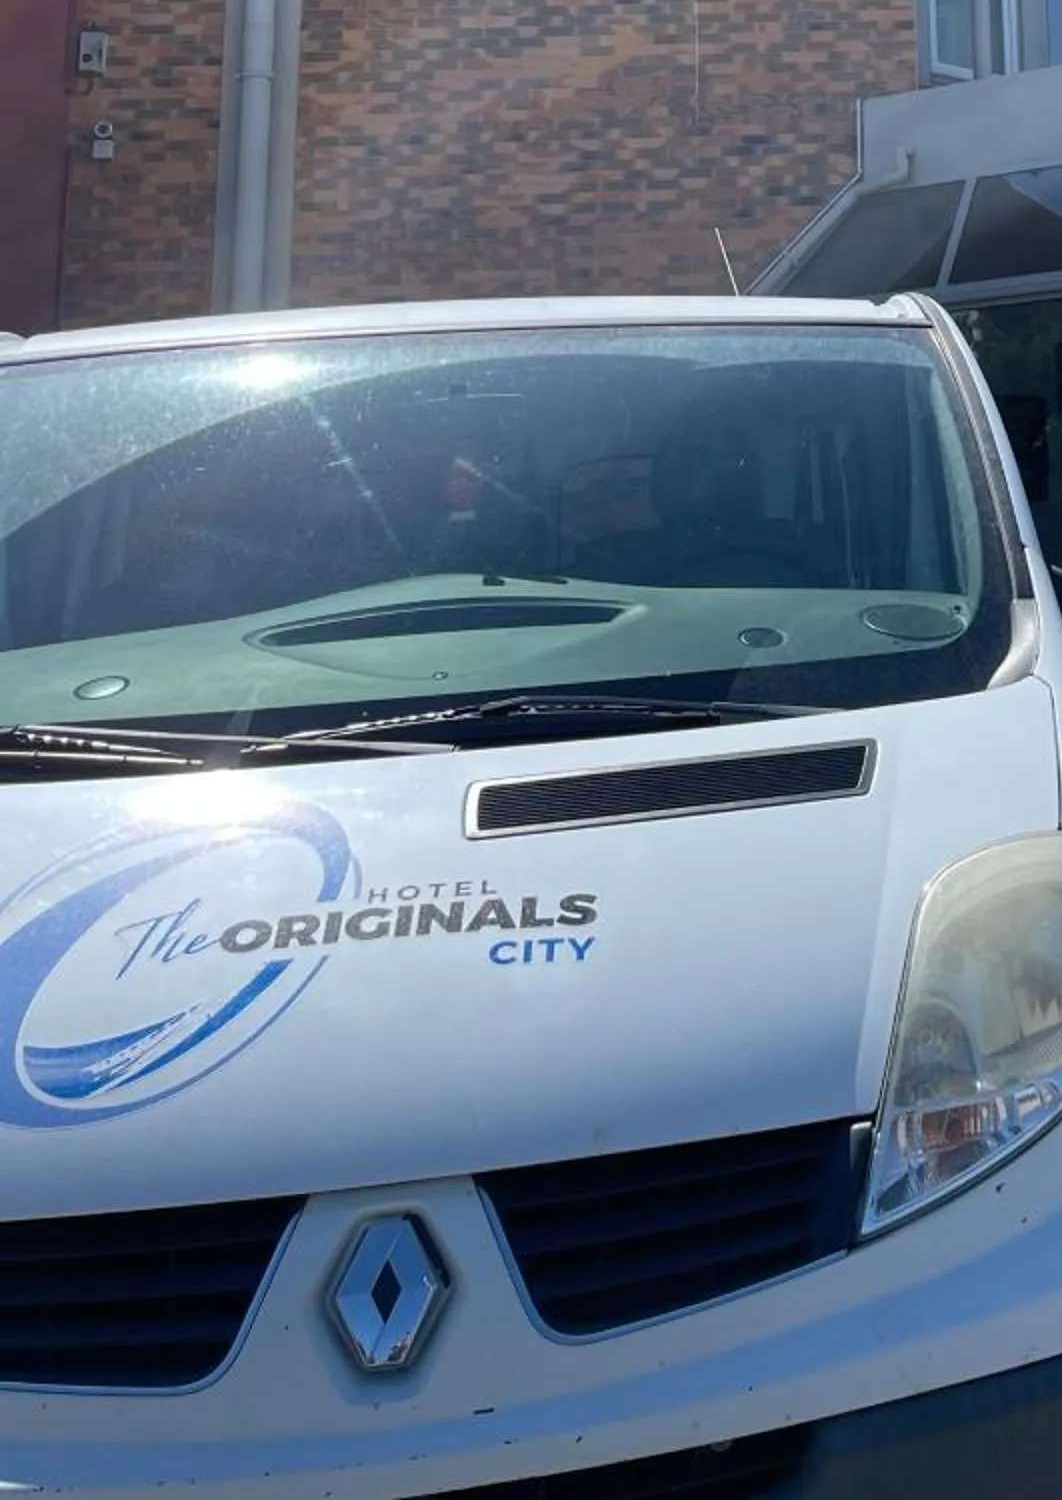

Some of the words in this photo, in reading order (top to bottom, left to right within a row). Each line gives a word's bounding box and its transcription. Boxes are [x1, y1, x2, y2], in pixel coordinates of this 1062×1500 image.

[368, 879, 498, 903] HOTEL
[115, 897, 224, 979] The
[220, 892, 598, 954] ORIGINALS
[488, 936, 596, 966] CITY
